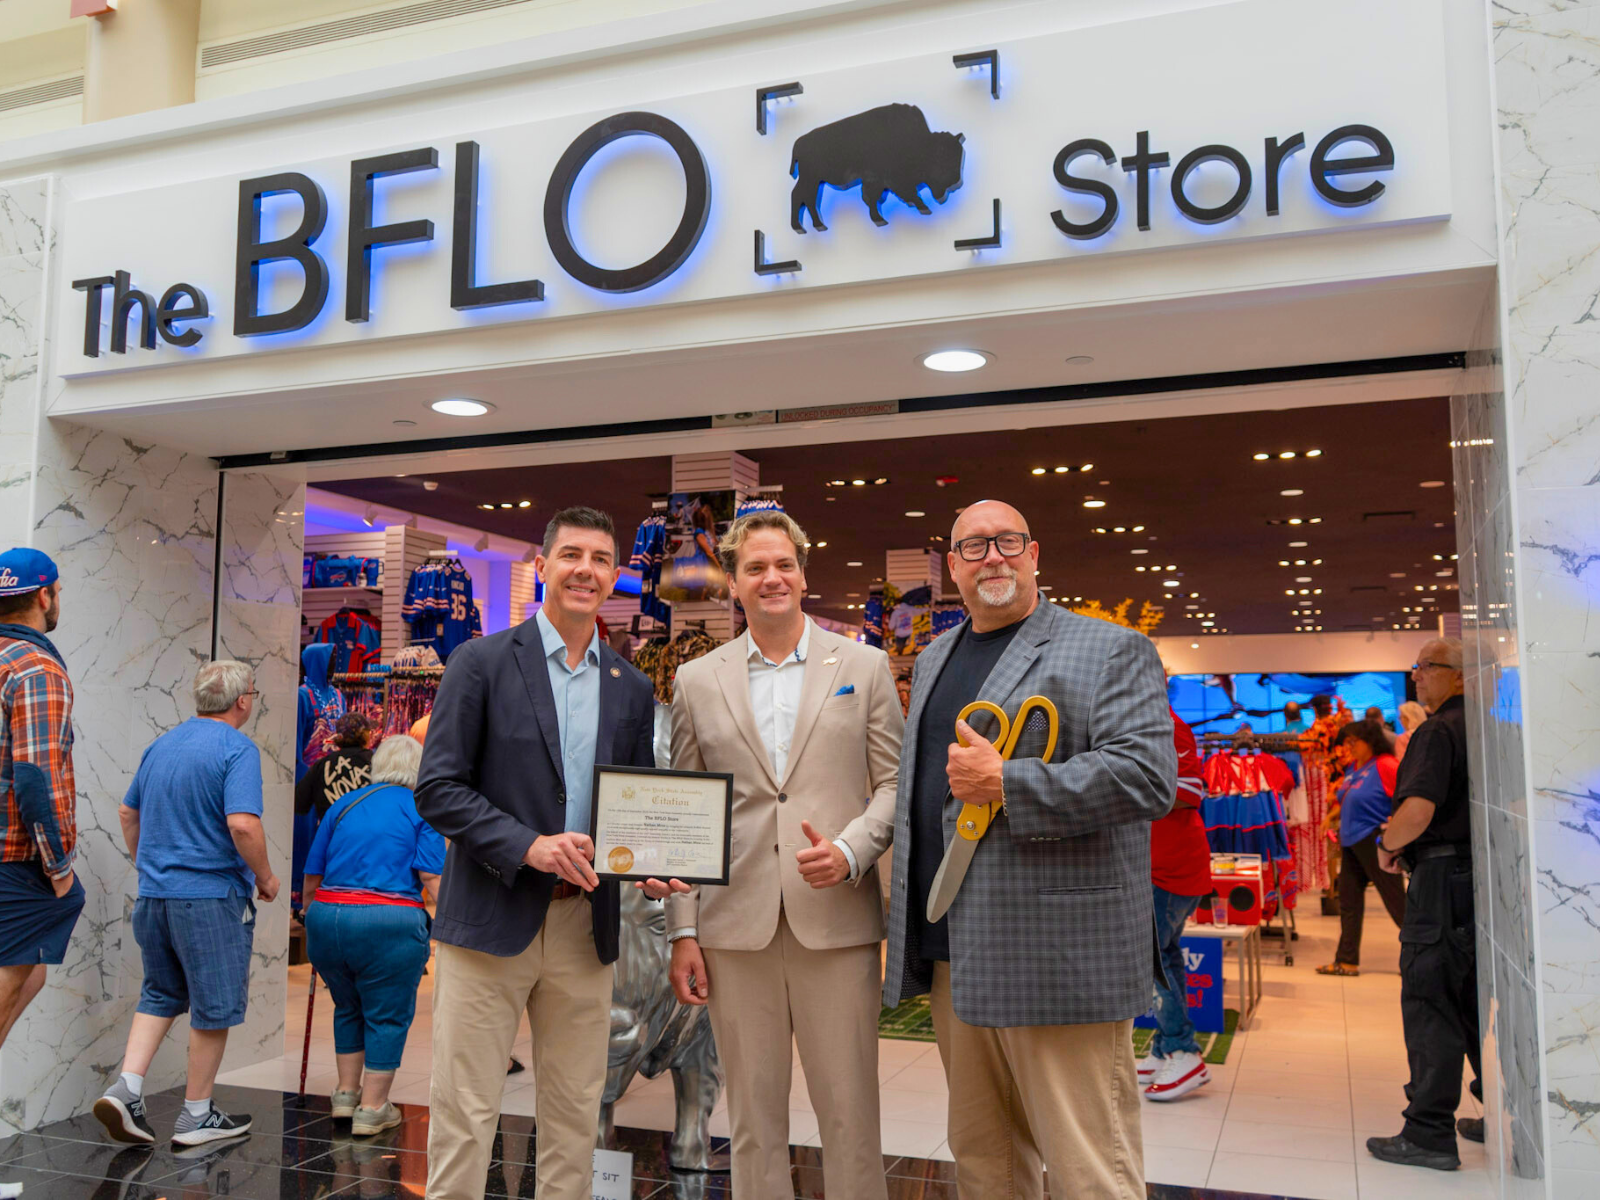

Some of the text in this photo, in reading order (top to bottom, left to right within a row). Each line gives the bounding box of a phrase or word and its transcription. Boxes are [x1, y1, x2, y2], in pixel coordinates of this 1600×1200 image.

[71, 111, 1395, 358] The BFLO Store
[782, 409, 818, 421] UNLOCKED
[820, 407, 847, 418] DURING
[324, 755, 352, 786] LA
[324, 764, 372, 805] NOVA
[651, 795, 690, 806] Citation
[602, 1172, 620, 1183] SIT
